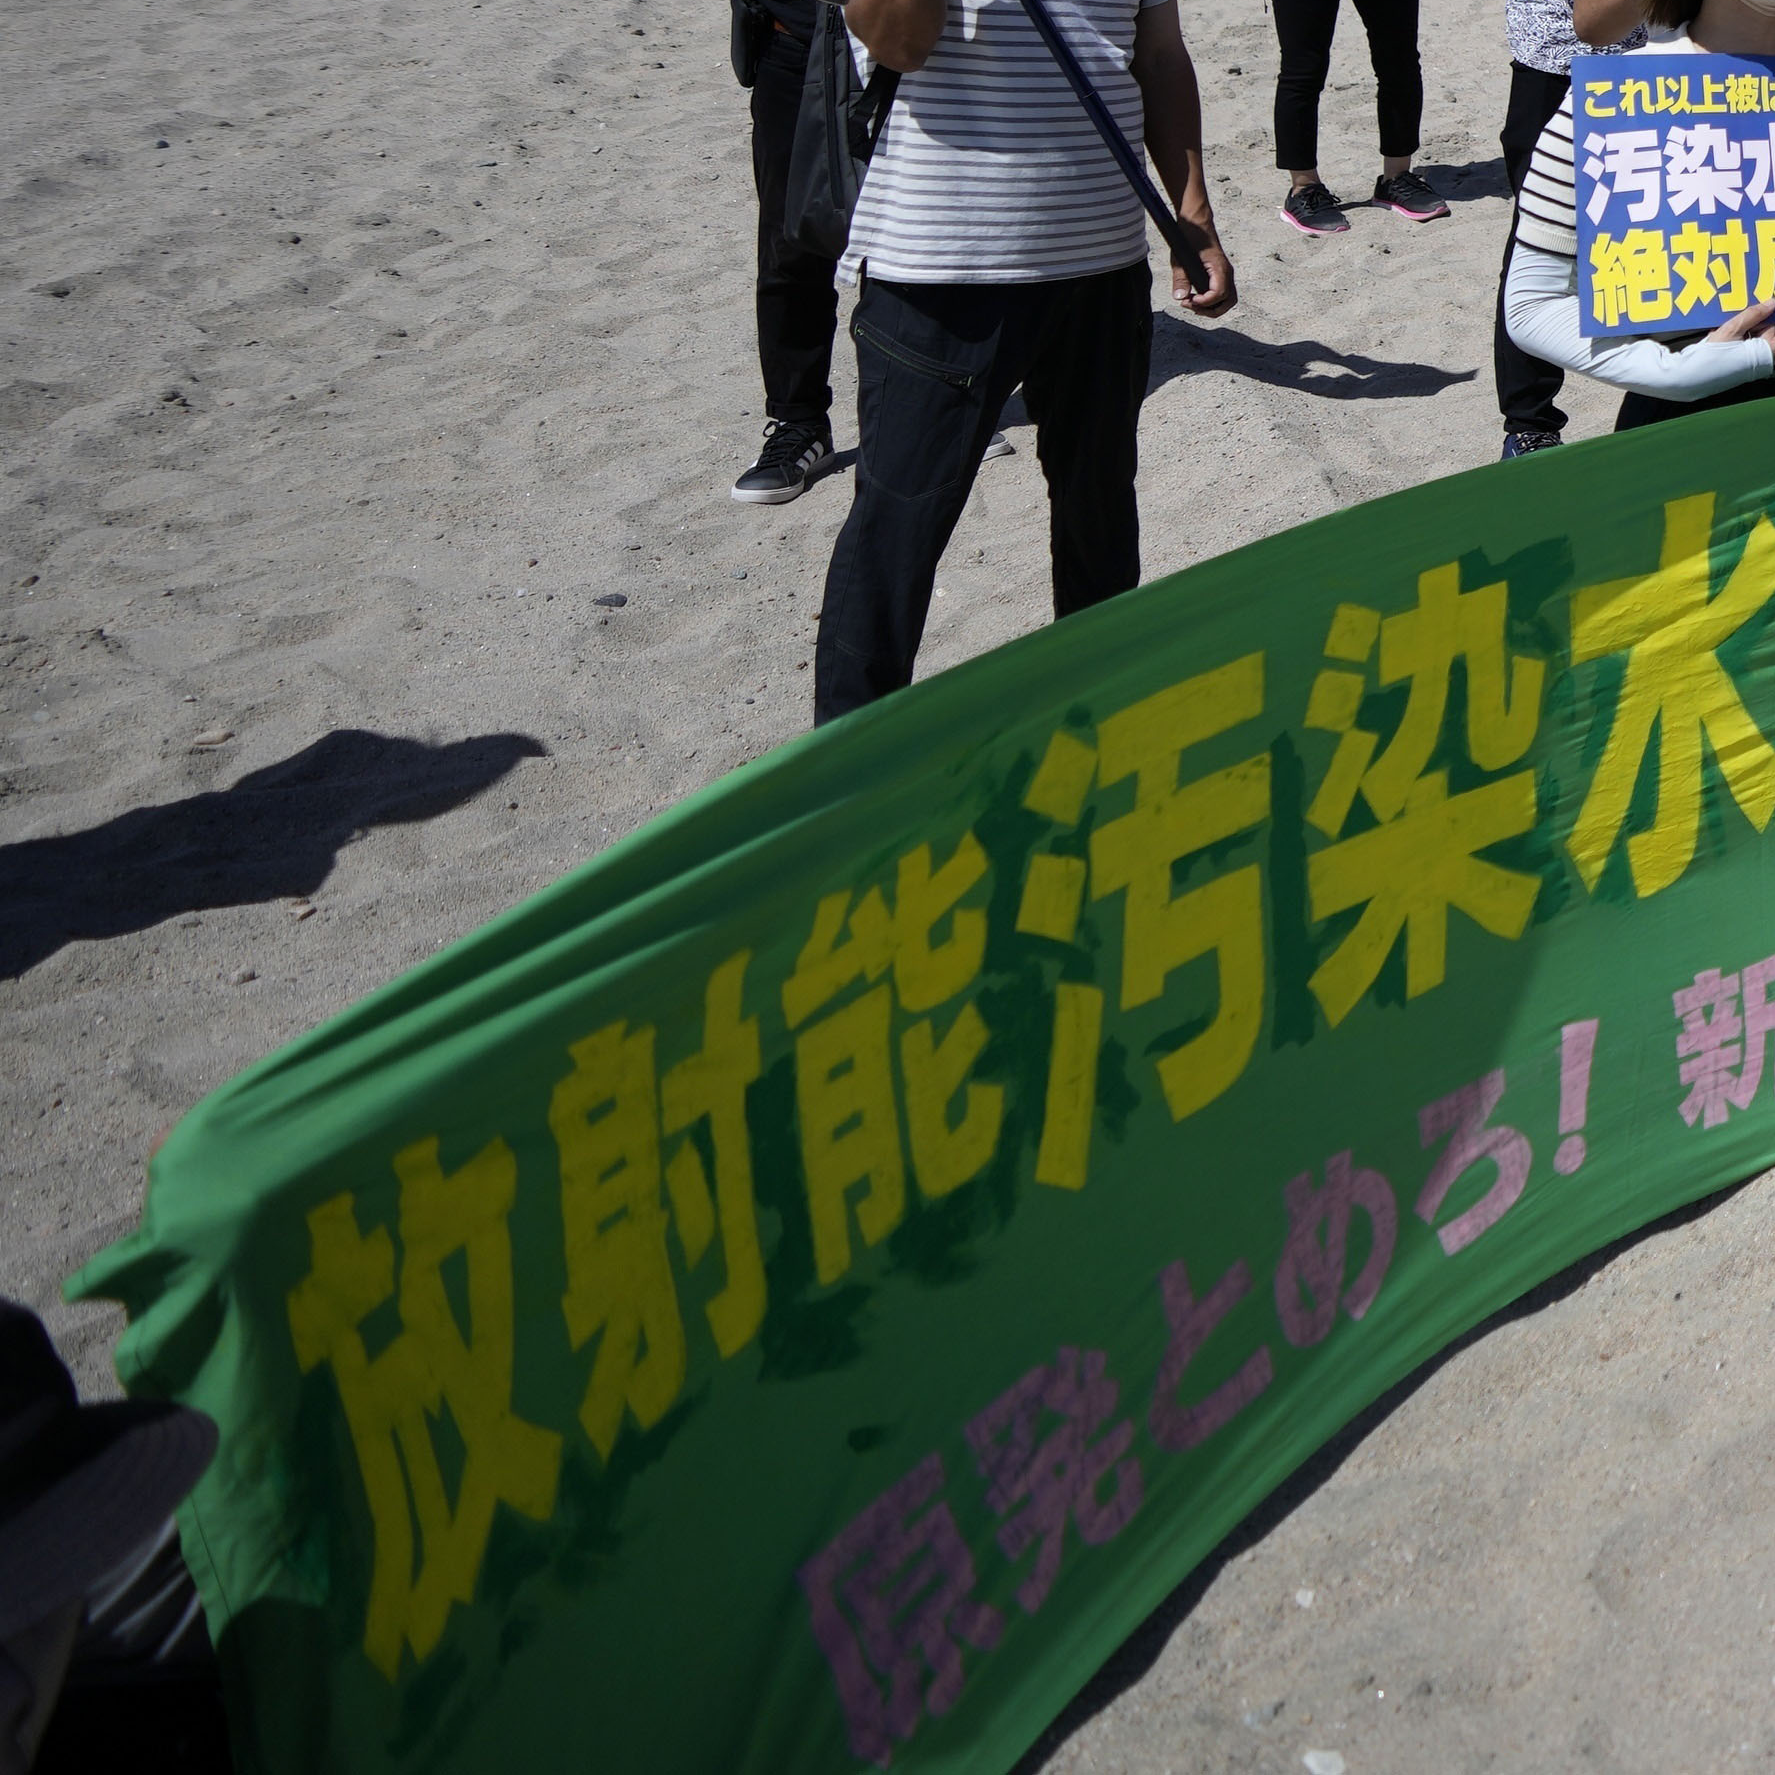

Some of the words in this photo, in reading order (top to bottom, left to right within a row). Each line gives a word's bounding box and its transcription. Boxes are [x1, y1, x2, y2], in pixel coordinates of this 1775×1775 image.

[796, 1018, 1599, 1768] 原発とめろ!
